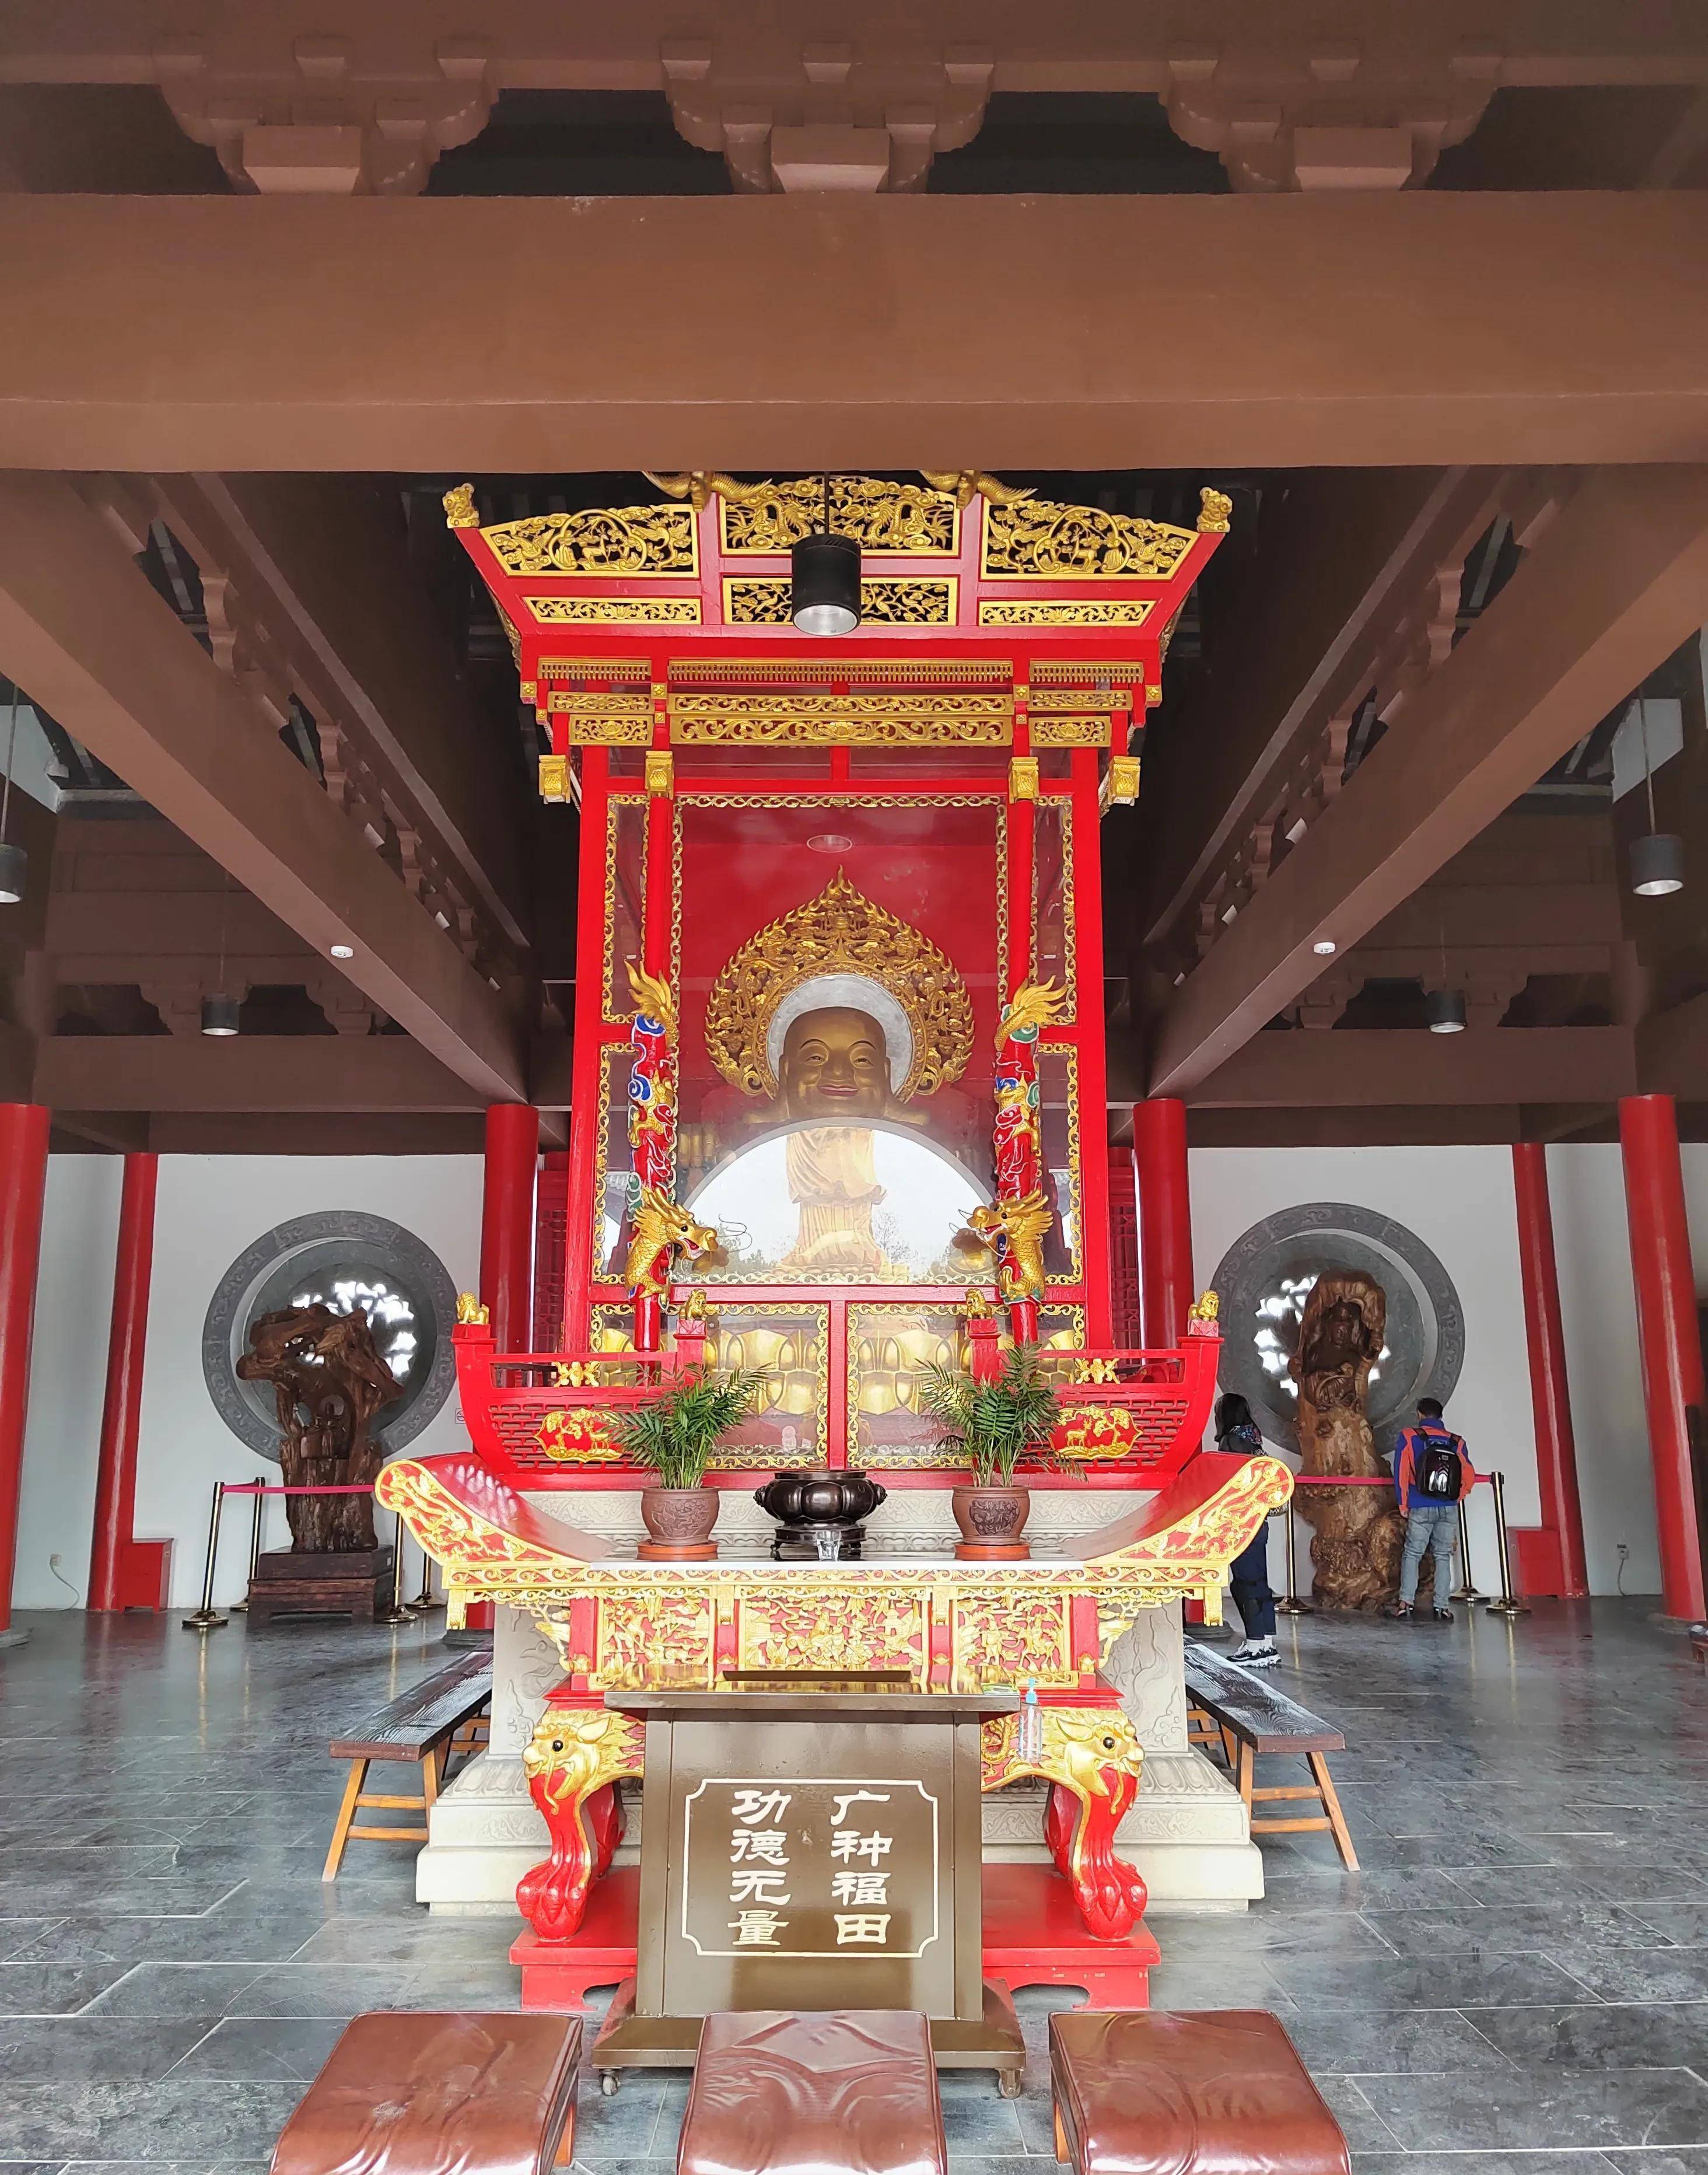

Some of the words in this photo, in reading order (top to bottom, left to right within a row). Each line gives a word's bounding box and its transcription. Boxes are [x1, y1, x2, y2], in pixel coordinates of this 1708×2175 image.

[727, 1789, 792, 1945] 功德无量
[830, 1790, 893, 1945] 广种福田
